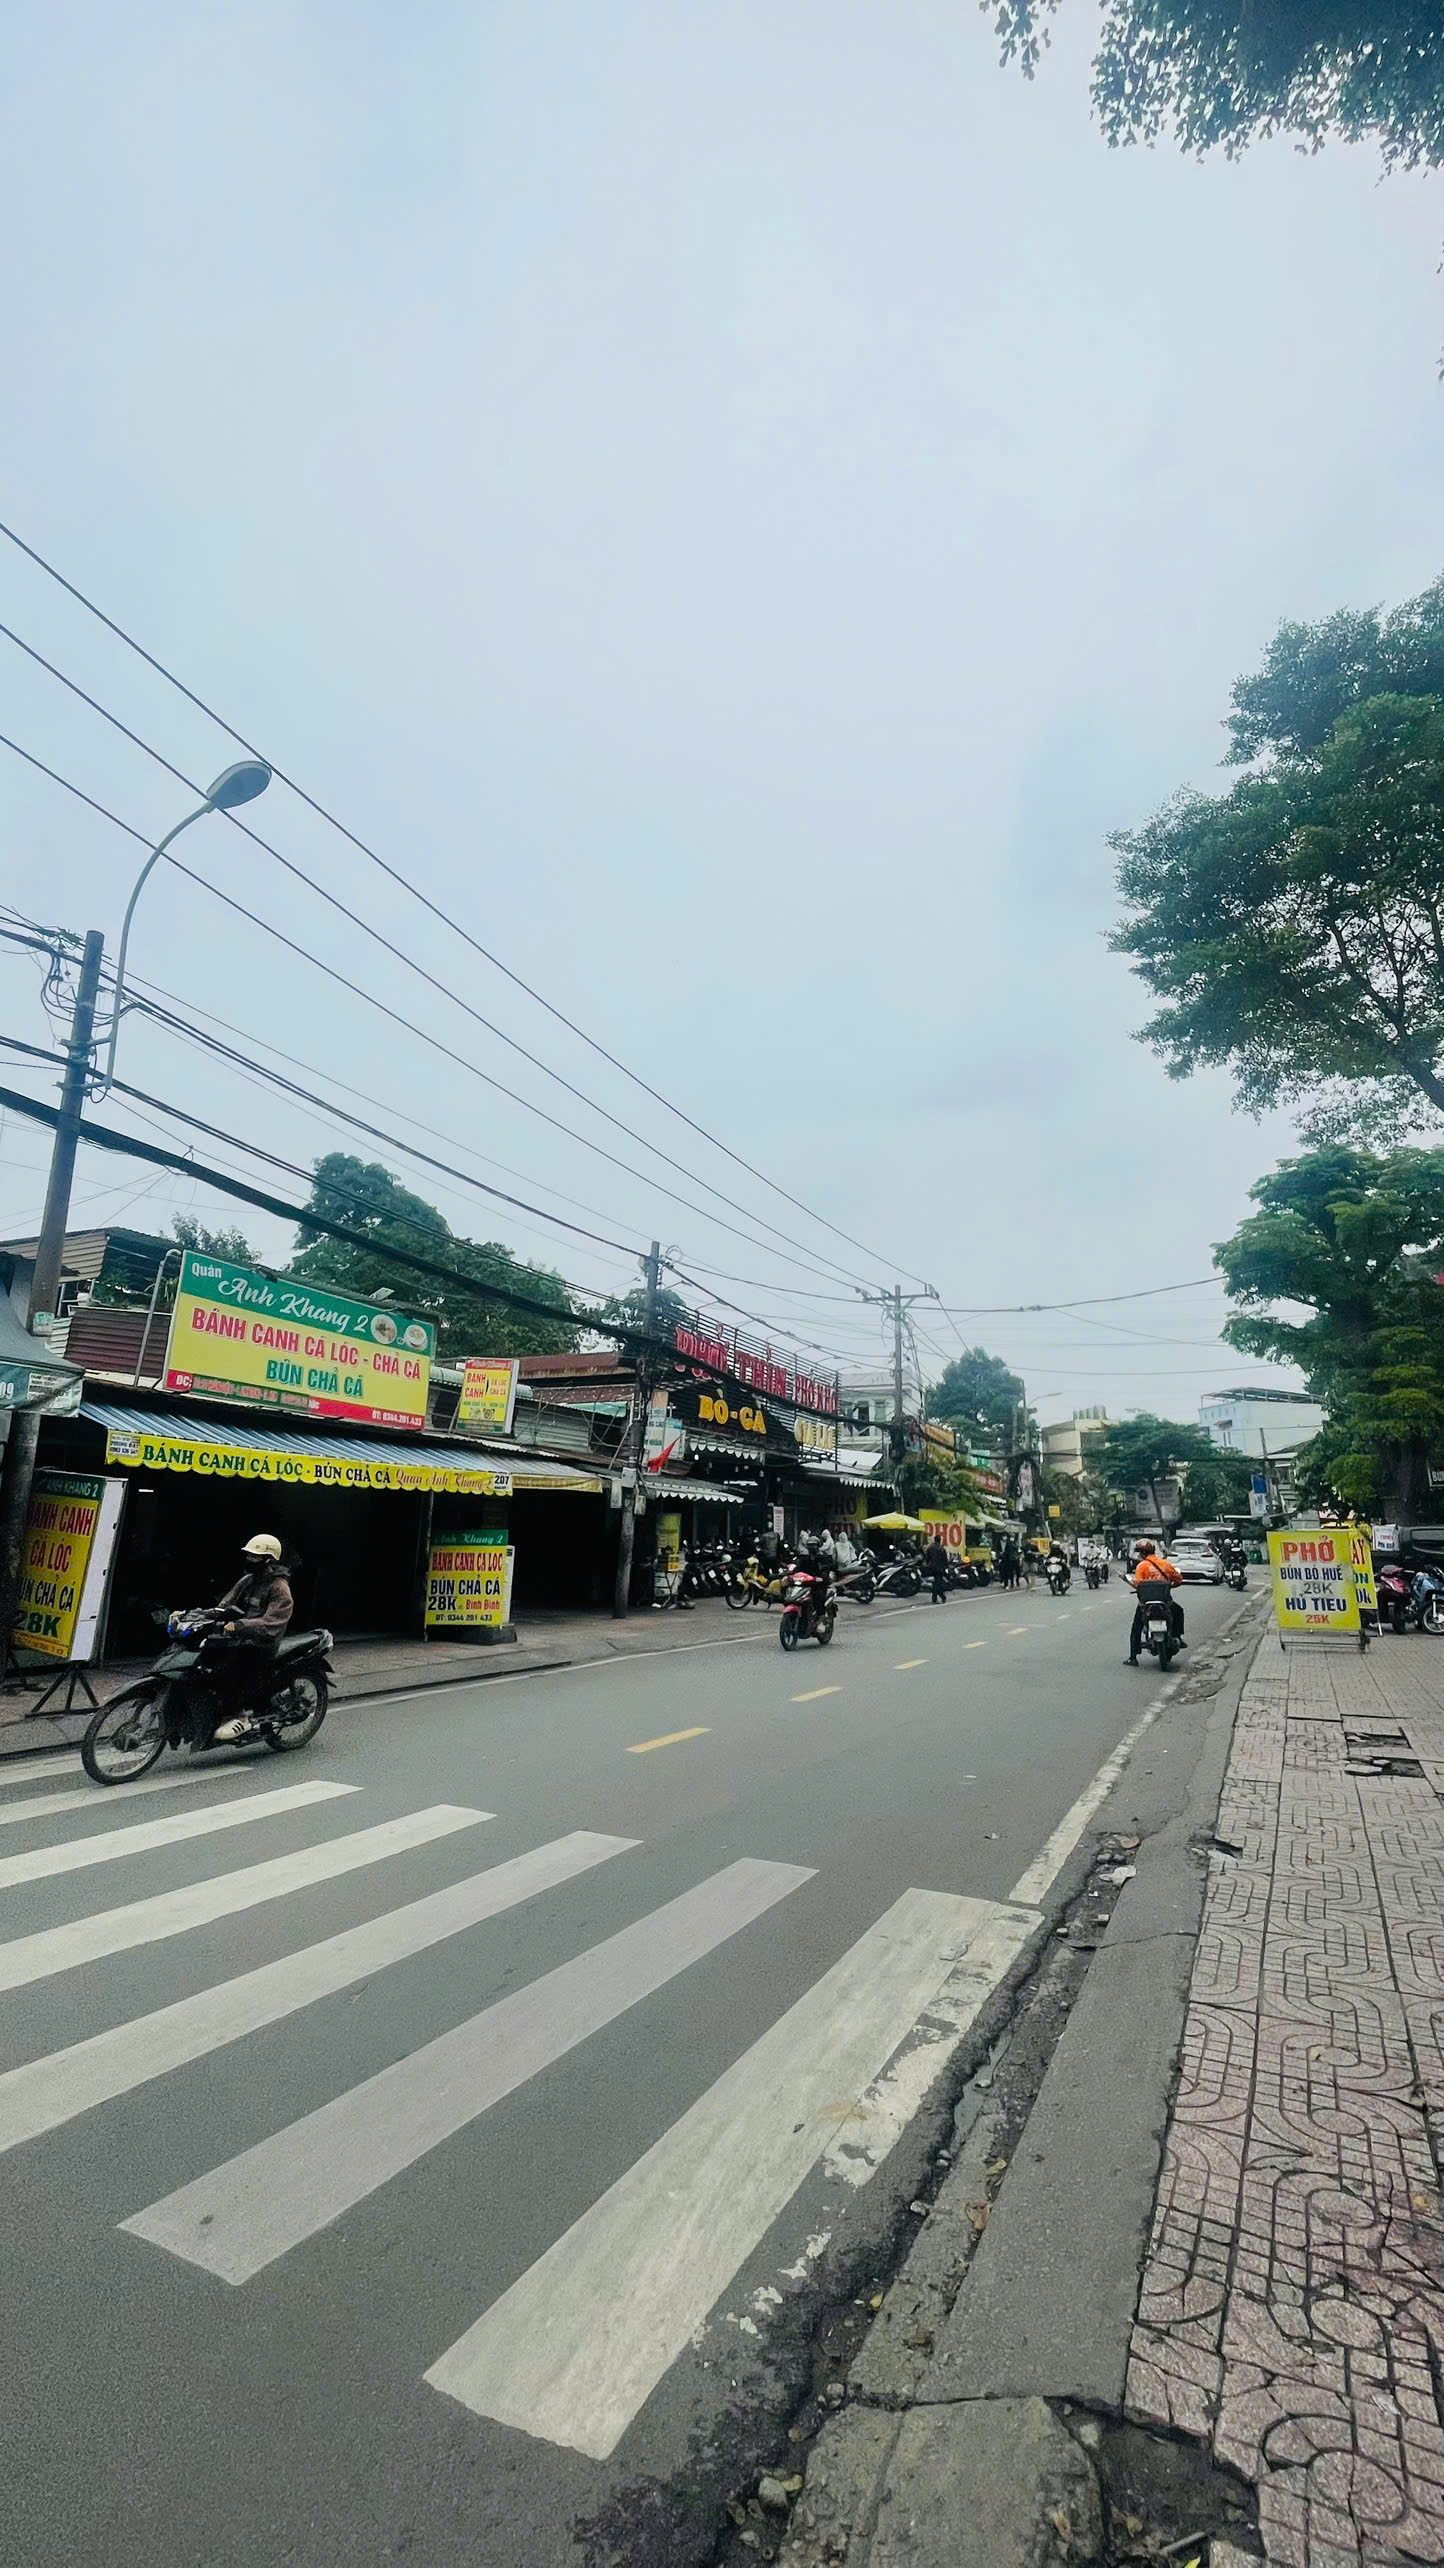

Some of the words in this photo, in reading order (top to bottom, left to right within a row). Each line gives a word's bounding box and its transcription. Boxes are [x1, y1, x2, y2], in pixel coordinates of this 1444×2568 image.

[191, 1262, 222, 1279] Quán
[218, 1277, 277, 1307] Anh
[279, 1293, 351, 1334] Khang
[353, 1314, 369, 1333] 2
[252, 1322, 299, 1353] CANH
[304, 1335, 325, 1359] CÁ
[330, 1341, 359, 1366] LÓC
[372, 1352, 400, 1376] CHẢ
[403, 1359, 421, 1380] CÁ
[307, 1367, 339, 1393] CHẢ
[343, 1376, 364, 1398] CÁ
[143, 1443, 195, 1465] BÁNH
[199, 1452, 245, 1471] CANH
[250, 1456, 270, 1473] CÁ
[276, 1458, 303, 1475] LÓC
[314, 1462, 342, 1479] BÚN
[346, 1464, 371, 1482] CHẢ
[375, 1467, 391, 1484] CÁ
[92, 1483, 99, 1497] 2
[494, 1475, 510, 1485] 207
[59, 1505, 95, 1537] CANH
[463, 1533, 494, 1544] Khang
[497, 1534, 503, 1544] 2
[1281, 1535, 1336, 1564] PHỞ
[30, 1535, 47, 1568] CÁ
[48, 1537, 72, 1573] LÓC
[455, 1551, 475, 1572] CANH
[1280, 1564, 1302, 1580] BÚN
[1305, 1564, 1319, 1580] BÒ
[1322, 1563, 1344, 1580] HUẾ
[34, 1574, 58, 1610] CHẢ
[59, 1581, 76, 1613] CÁ
[431, 1576, 455, 1595] BÚN
[458, 1574, 482, 1595] CHẢ
[485, 1576, 500, 1595] CÁ
[1303, 1583, 1333, 1595] 28K
[428, 1596, 457, 1611] 28K
[16, 1609, 61, 1639] 28K
